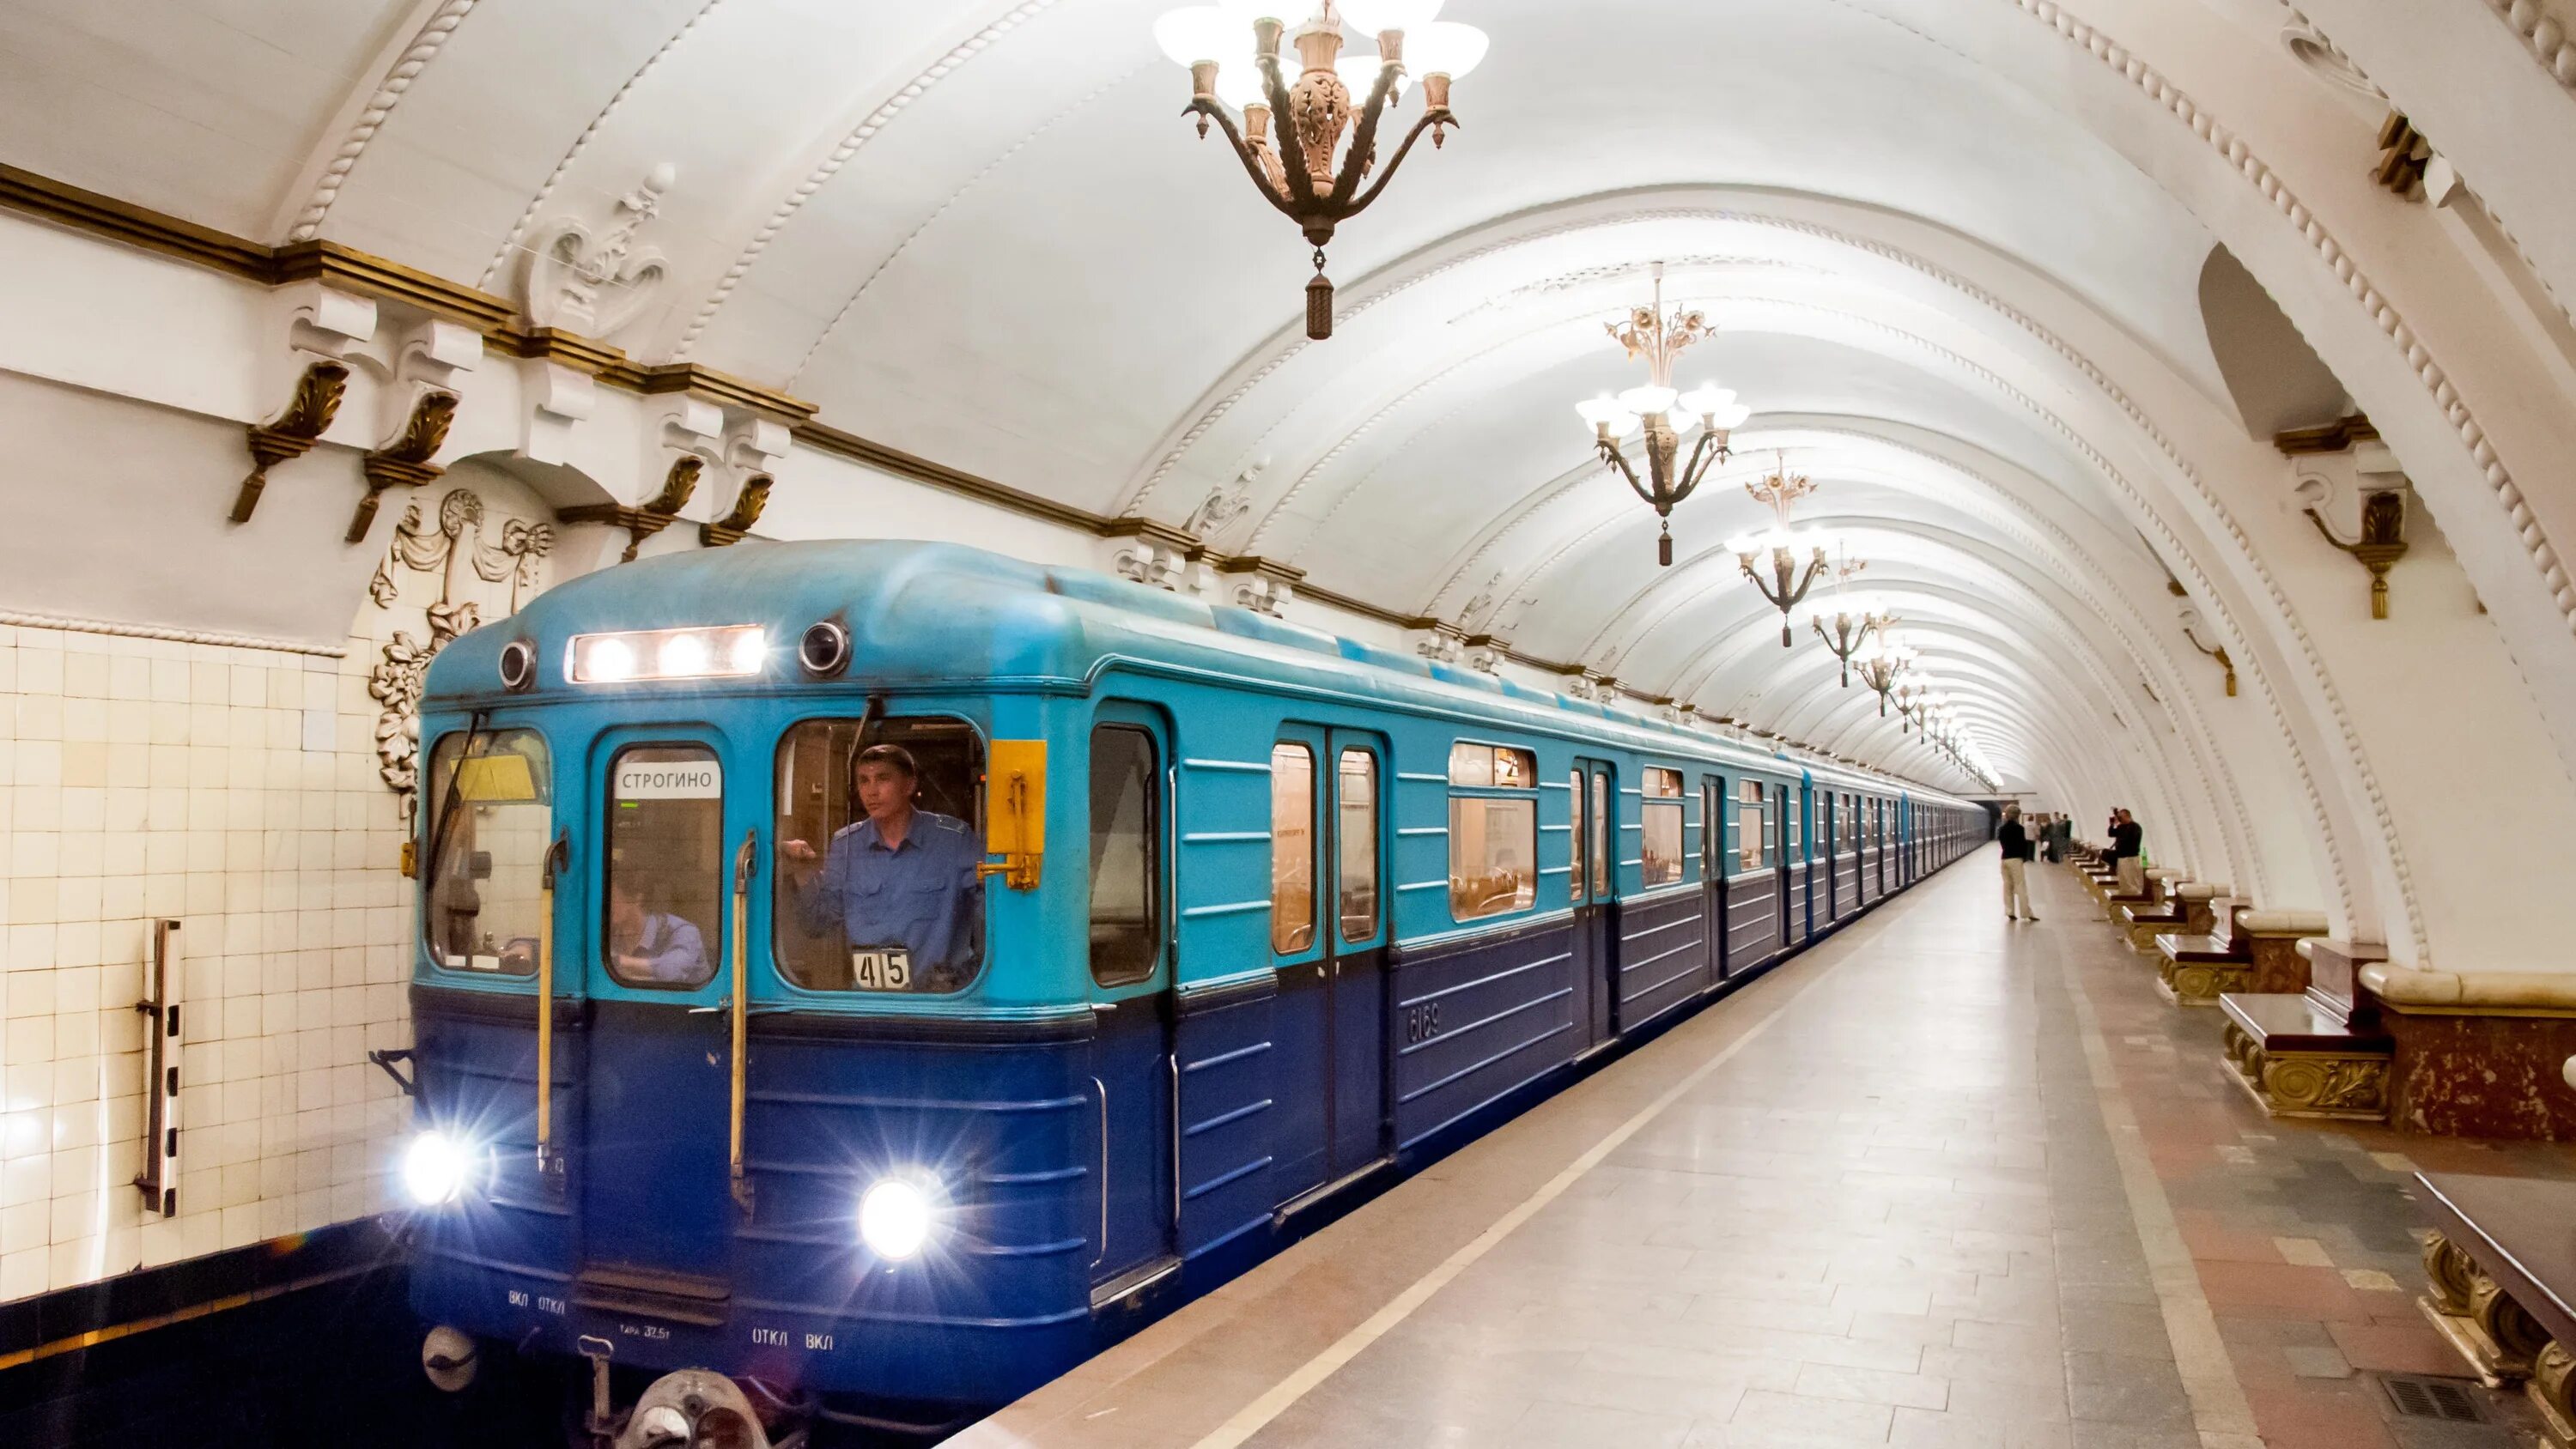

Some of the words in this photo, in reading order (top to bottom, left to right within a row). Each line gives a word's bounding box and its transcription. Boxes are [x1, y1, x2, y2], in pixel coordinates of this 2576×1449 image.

[623, 772, 712, 789] СТРОГИНО
[1409, 1003, 1439, 1042] 6169
[508, 1290, 528, 1307] ВКЛ
[538, 1296, 566, 1315] ОТКЛ
[751, 1327, 788, 1347] ОТКЛ
[805, 1333, 834, 1352] ВКЛ
